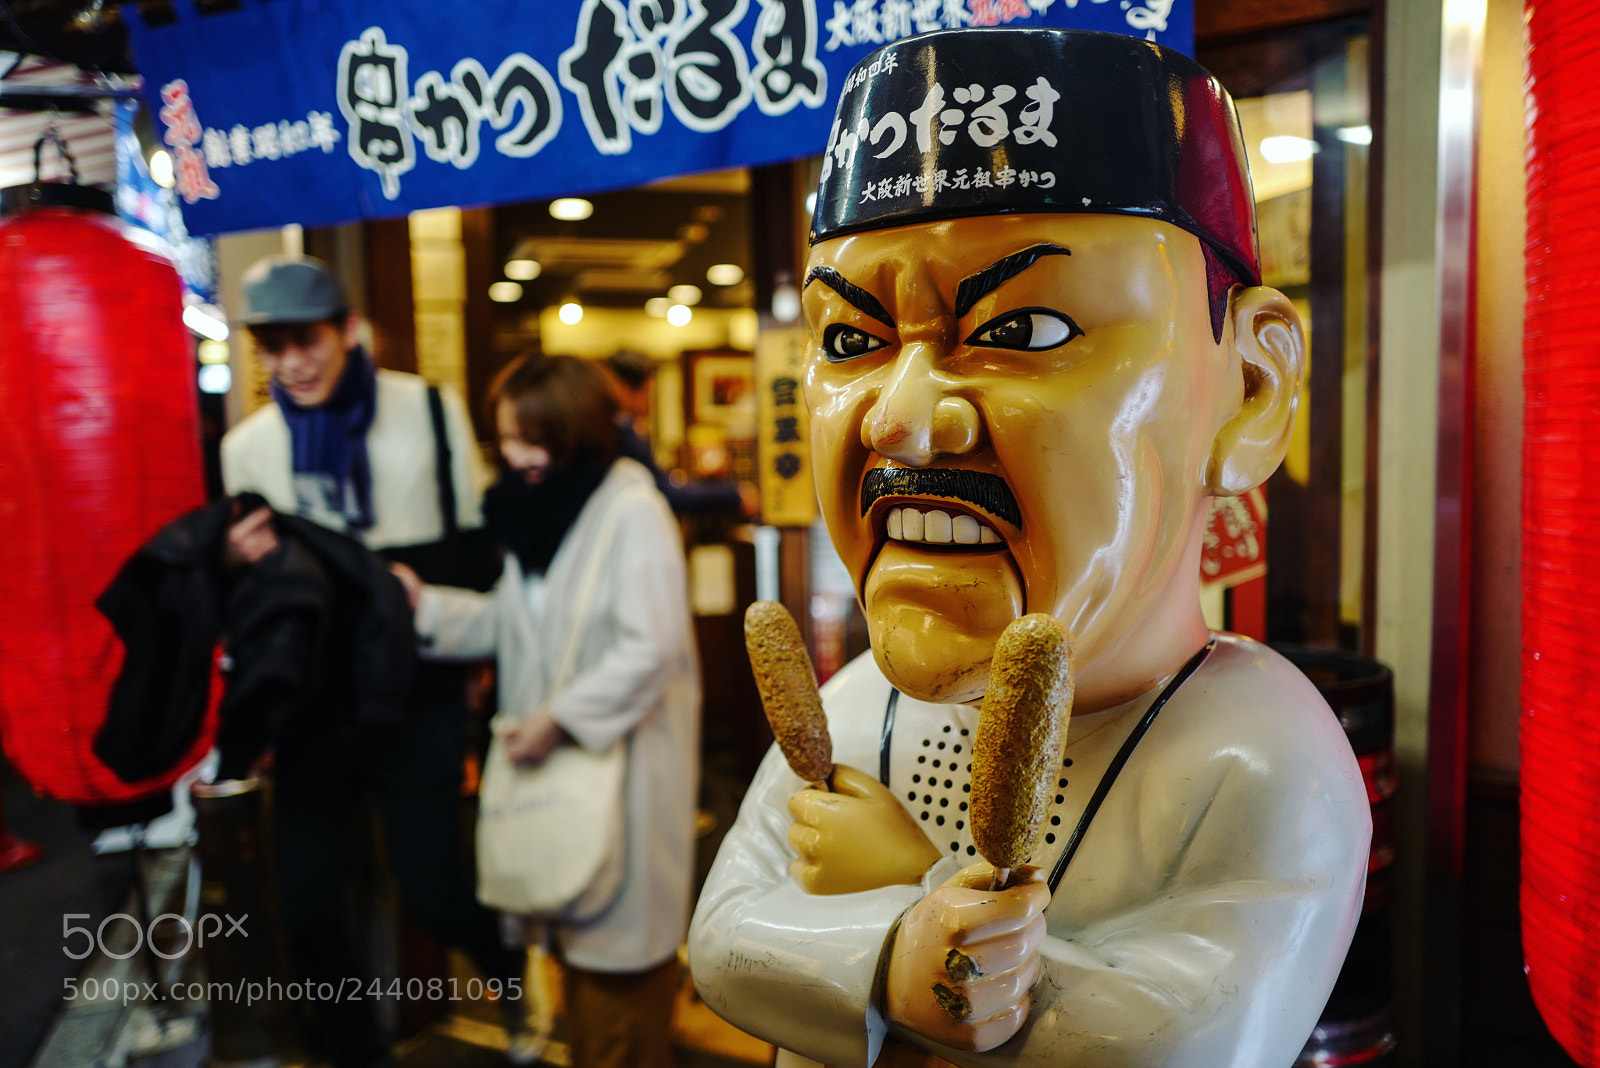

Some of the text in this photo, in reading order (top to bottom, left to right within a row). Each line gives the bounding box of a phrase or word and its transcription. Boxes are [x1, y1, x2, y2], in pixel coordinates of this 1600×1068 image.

[859, 166, 1056, 204] 大阪新世界元祖串かつ
